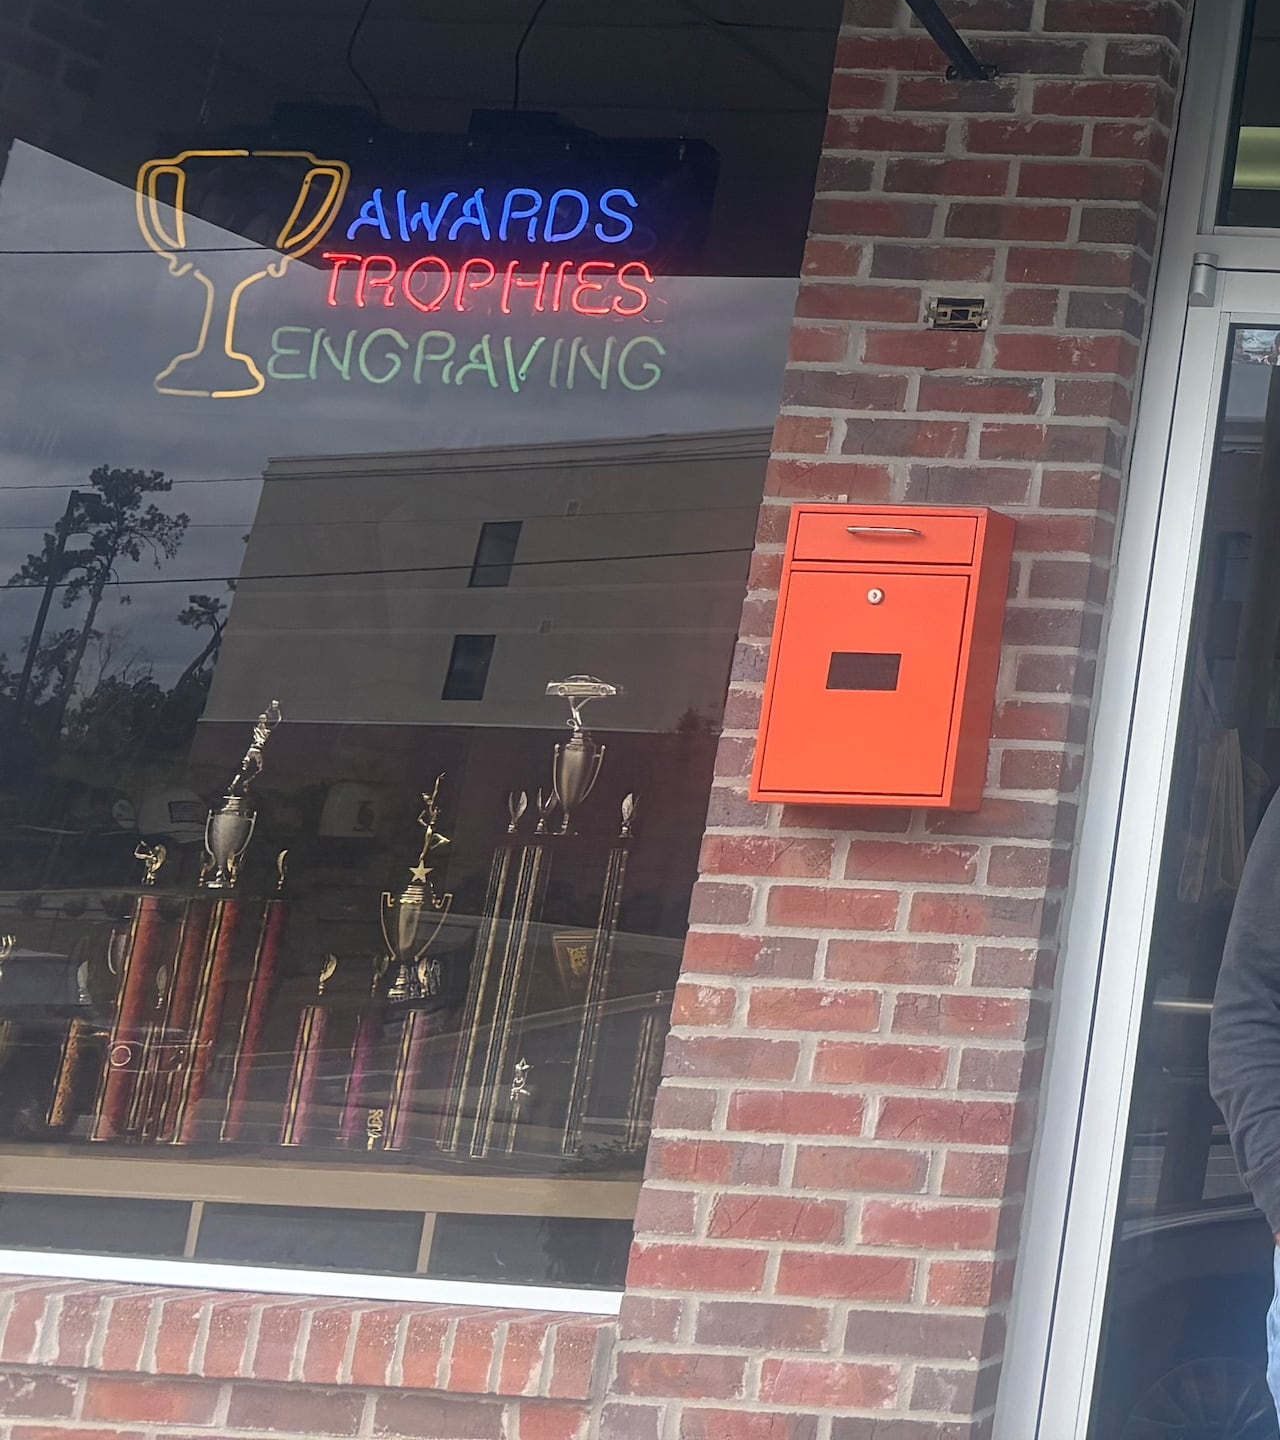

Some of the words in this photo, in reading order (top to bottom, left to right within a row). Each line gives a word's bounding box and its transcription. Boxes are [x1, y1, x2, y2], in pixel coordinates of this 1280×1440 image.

[347, 188, 639, 243] AWARDS
[322, 252, 655, 315] TROPHIES
[267, 325, 667, 392] ENGRAVING
